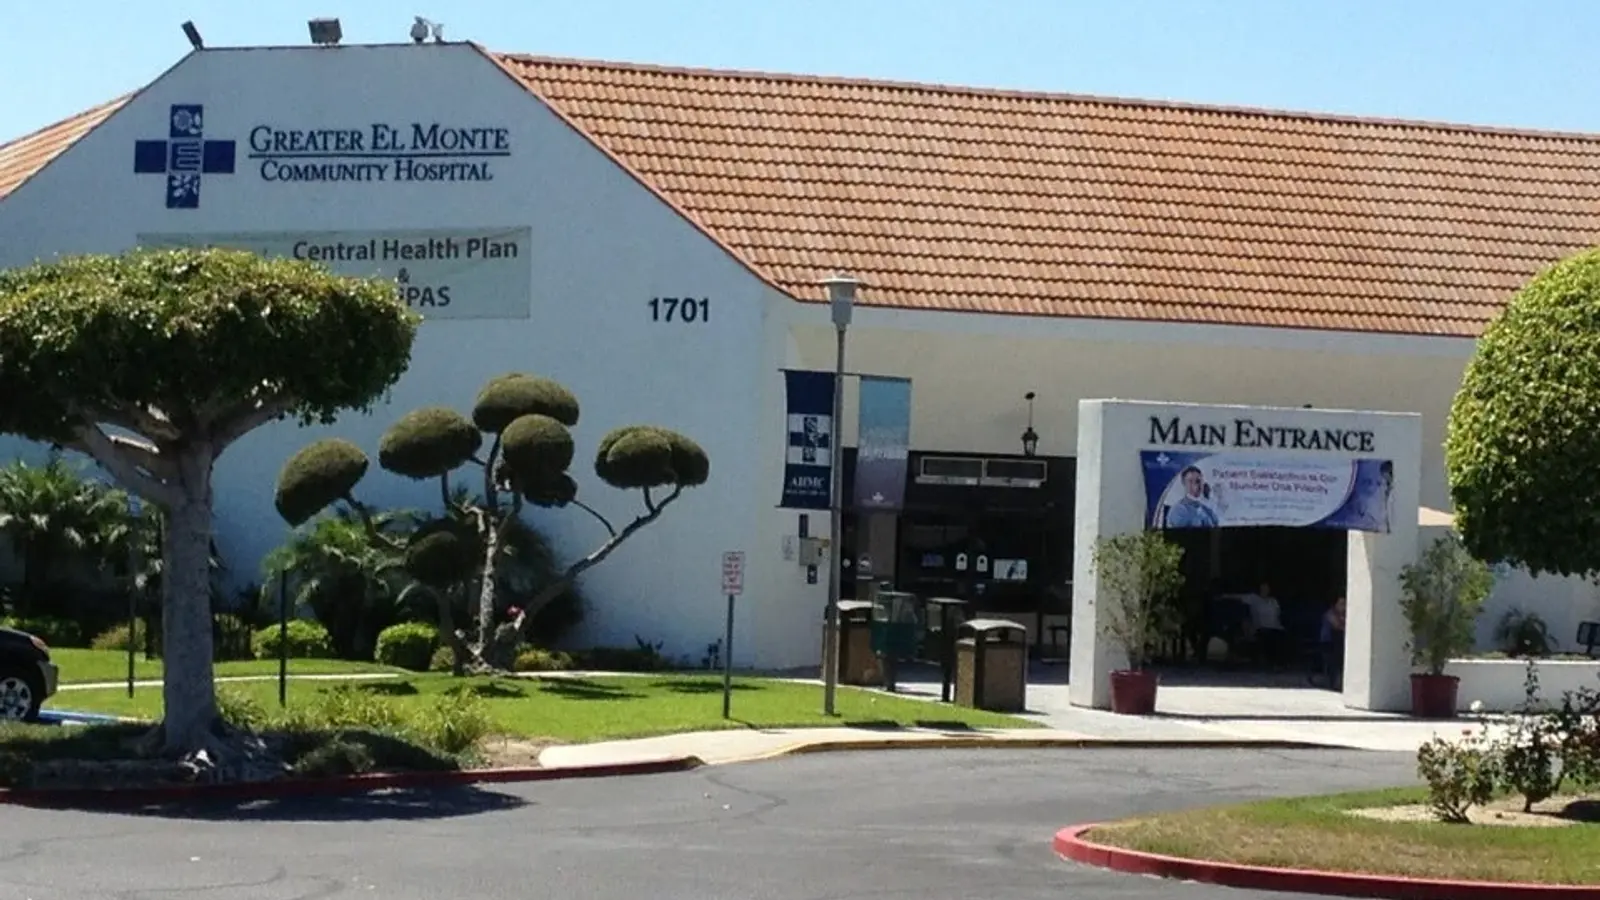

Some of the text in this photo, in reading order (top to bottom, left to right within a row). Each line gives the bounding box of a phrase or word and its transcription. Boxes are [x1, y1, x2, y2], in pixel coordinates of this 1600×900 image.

[249, 122, 510, 152] GREATER EL MONTE
[260, 158, 494, 182] COMMUNITY HOSPITAL
[292, 236, 519, 261] Central Health Plan
[648, 297, 709, 323] 1701
[1149, 416, 1375, 453] MAIN ENTRANCE
